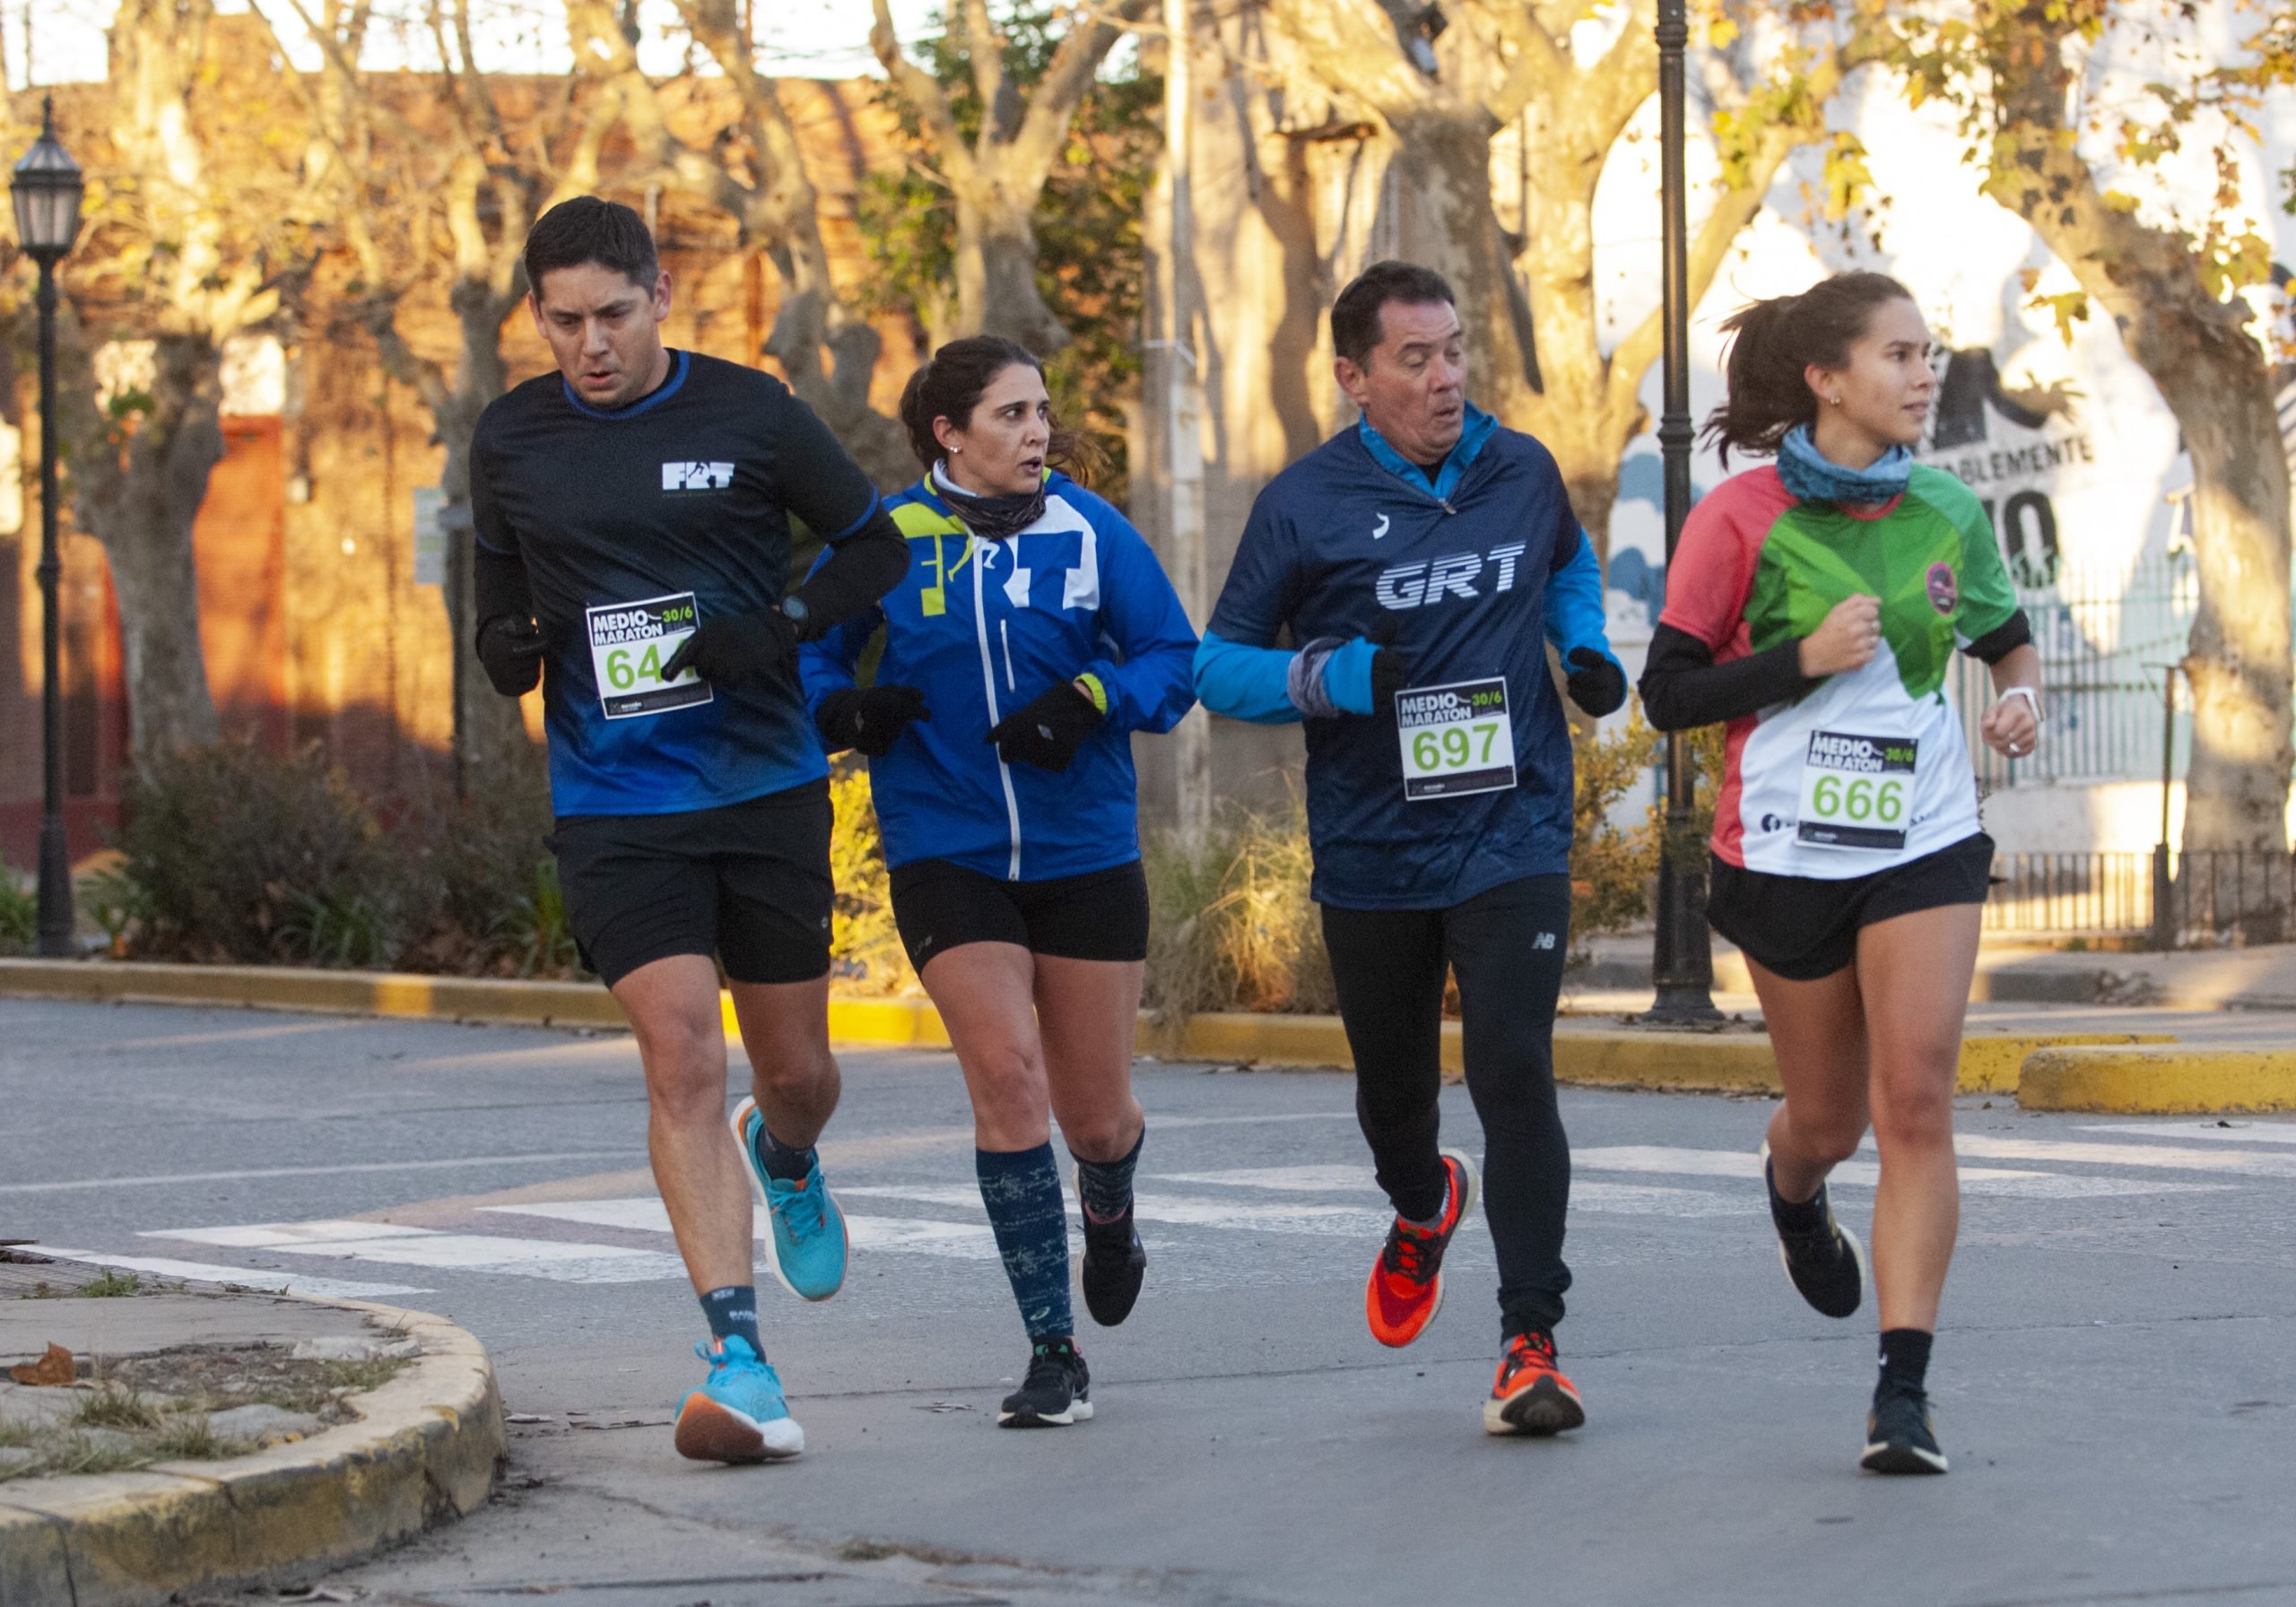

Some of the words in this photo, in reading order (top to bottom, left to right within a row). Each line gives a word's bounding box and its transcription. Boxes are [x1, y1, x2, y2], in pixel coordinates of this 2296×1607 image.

[1376, 541, 1526, 610] GRT
[593, 609, 648, 633] MEDIO
[662, 606, 693, 623] 30/6
[594, 622, 664, 647] MARATON
[1401, 691, 1458, 715] MEDIO
[1471, 690, 1503, 707] 30/6
[1401, 706, 1472, 728] MARATON
[1413, 722, 1499, 771] 697
[1812, 734, 1874, 759] MEDIO
[1808, 752, 1883, 773] MARATON
[1813, 775, 1903, 823] 666
